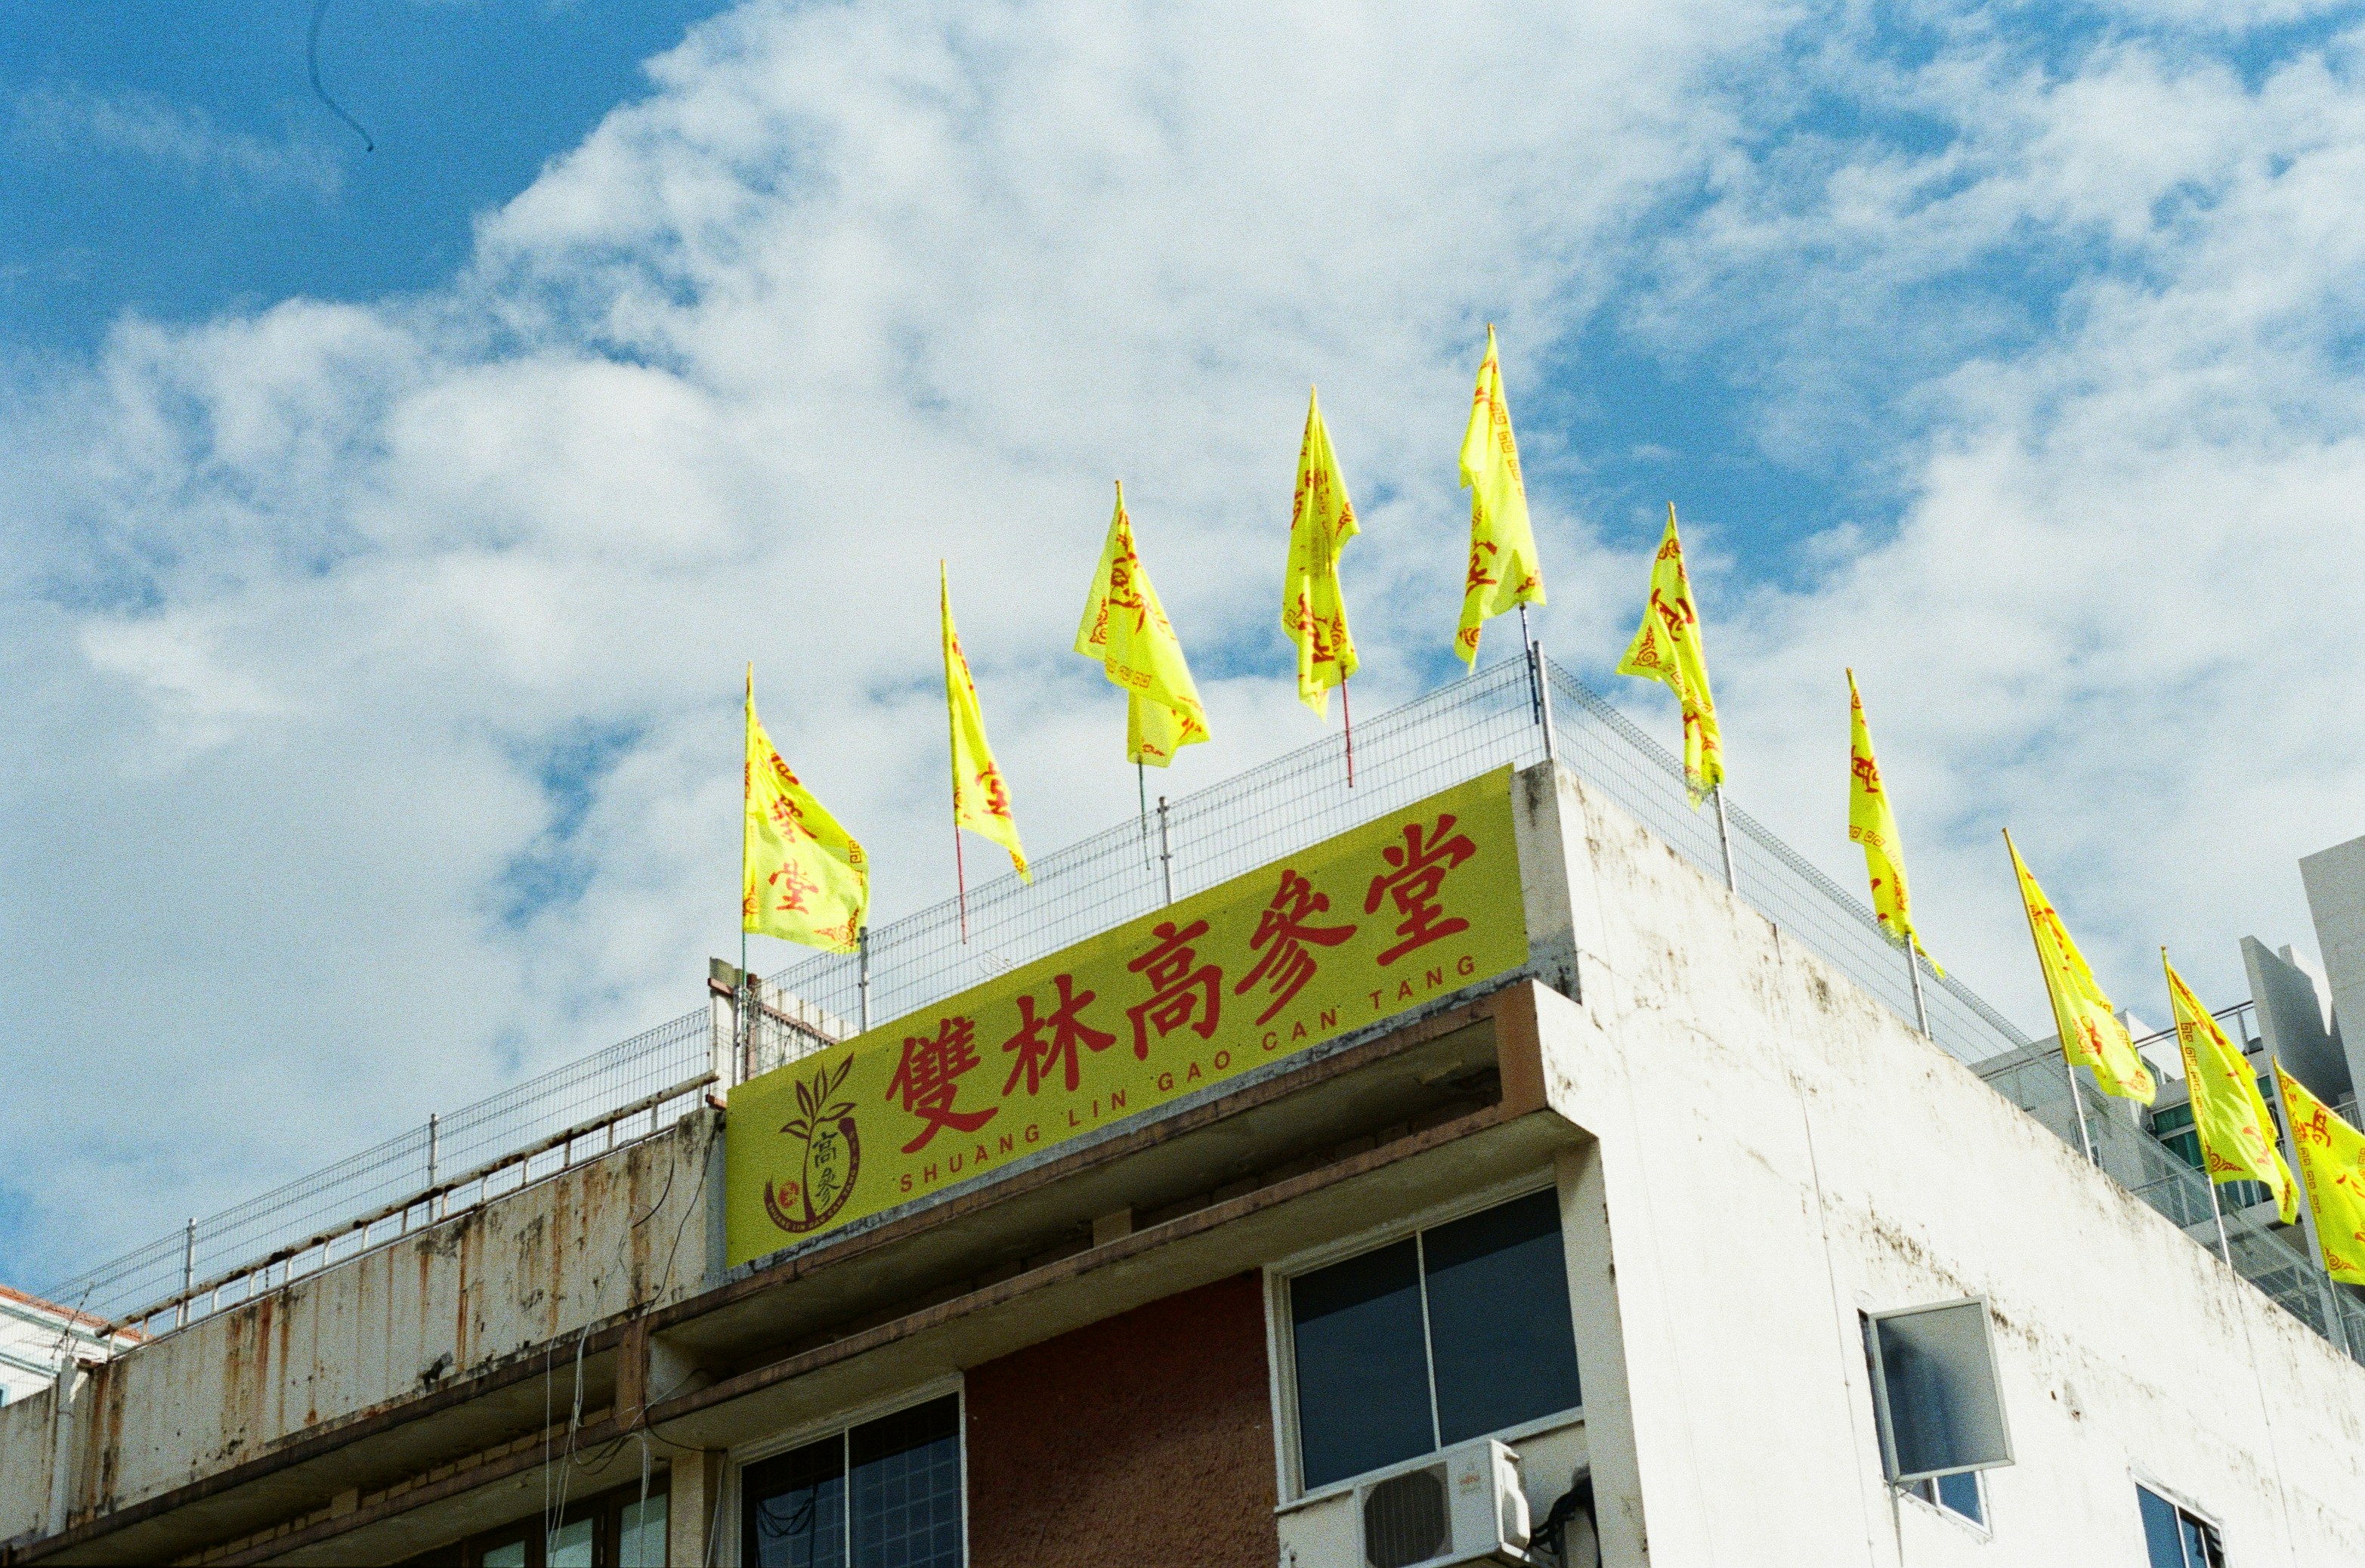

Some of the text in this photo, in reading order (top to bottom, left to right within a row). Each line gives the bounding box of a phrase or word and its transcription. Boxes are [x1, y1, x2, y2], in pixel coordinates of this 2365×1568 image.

[899, 1124, 1040, 1194] SHUANG
[1068, 1089, 1127, 1127] LIN
[1158, 1050, 1232, 1092] GAO
[1262, 1007, 1339, 1051] CAN
[1368, 954, 1475, 1009] TANG
